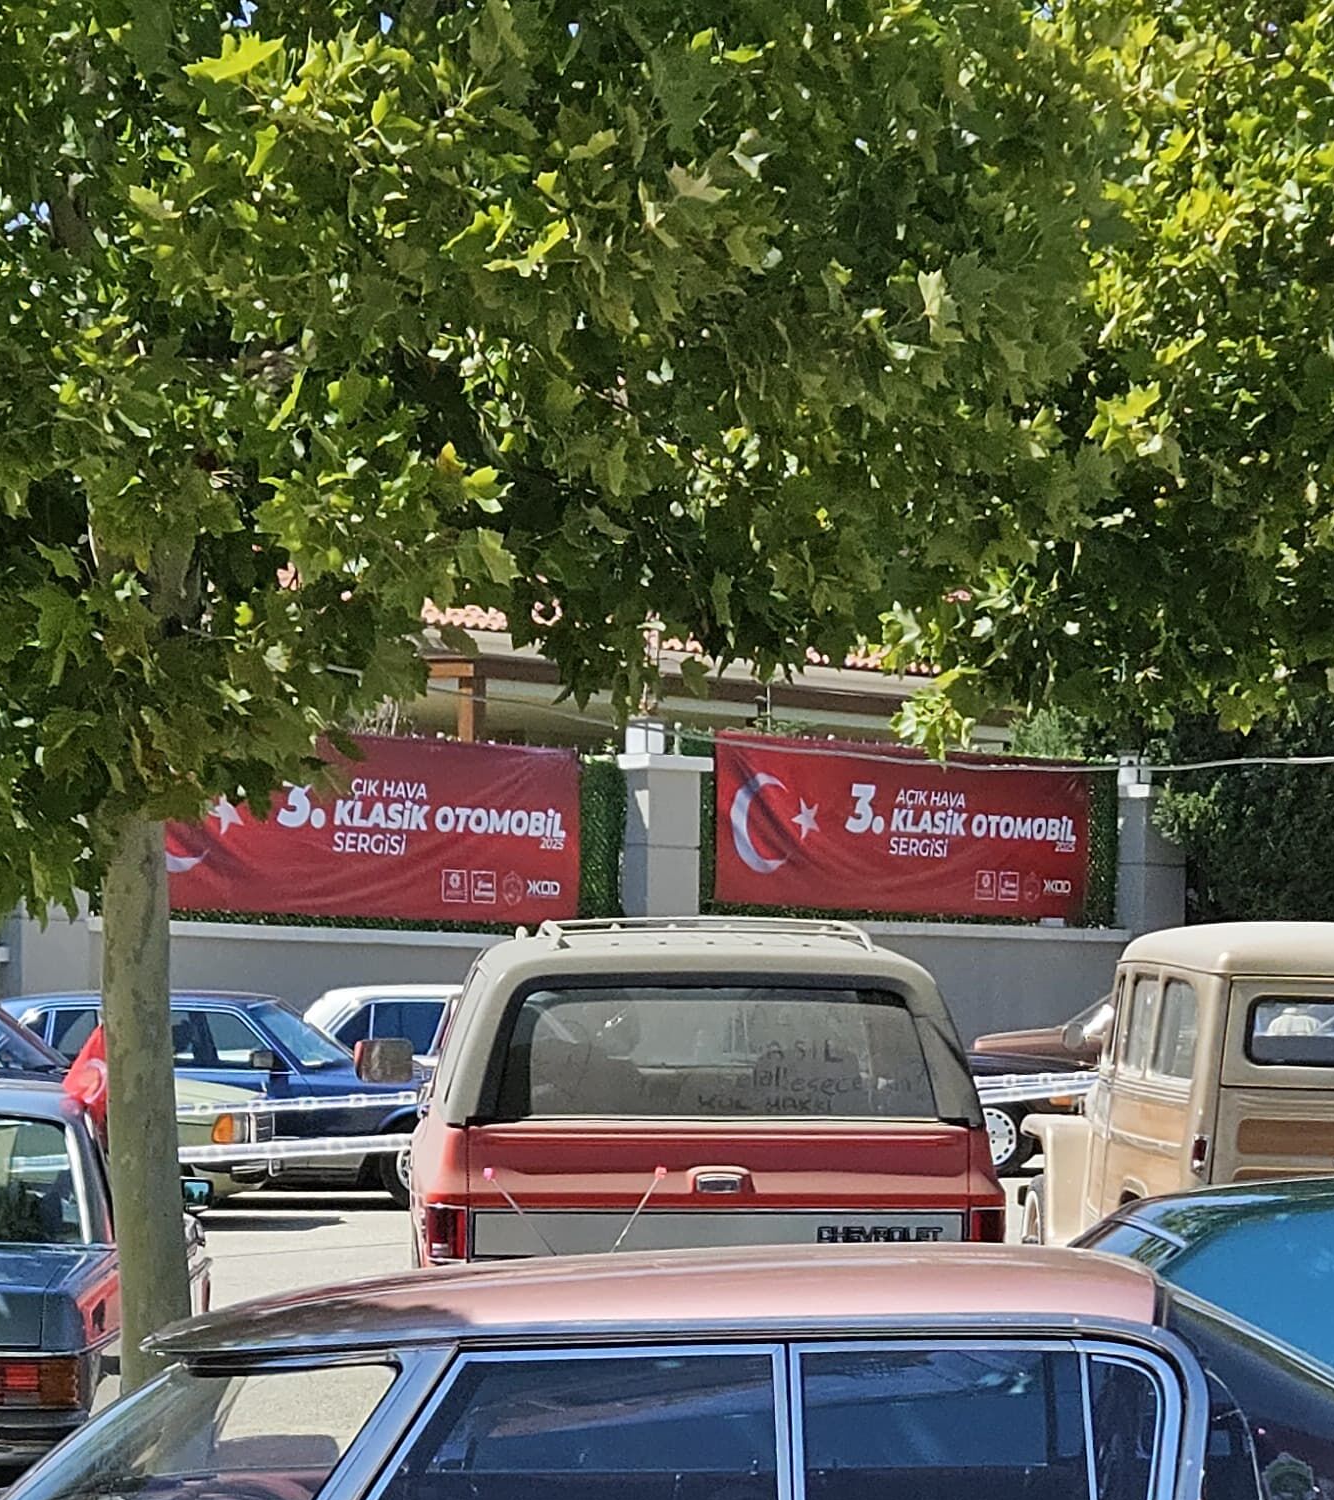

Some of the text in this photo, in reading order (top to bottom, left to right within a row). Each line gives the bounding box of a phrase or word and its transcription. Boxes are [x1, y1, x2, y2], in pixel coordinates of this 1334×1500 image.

[348, 778, 427, 800] ÇIK HAVA
[895, 788, 966, 809] AÇIK HAVA
[845, 783, 884, 834] 3.
[539, 837, 564, 850] 2025
[817, 1226, 944, 1243] CHEVROLET
